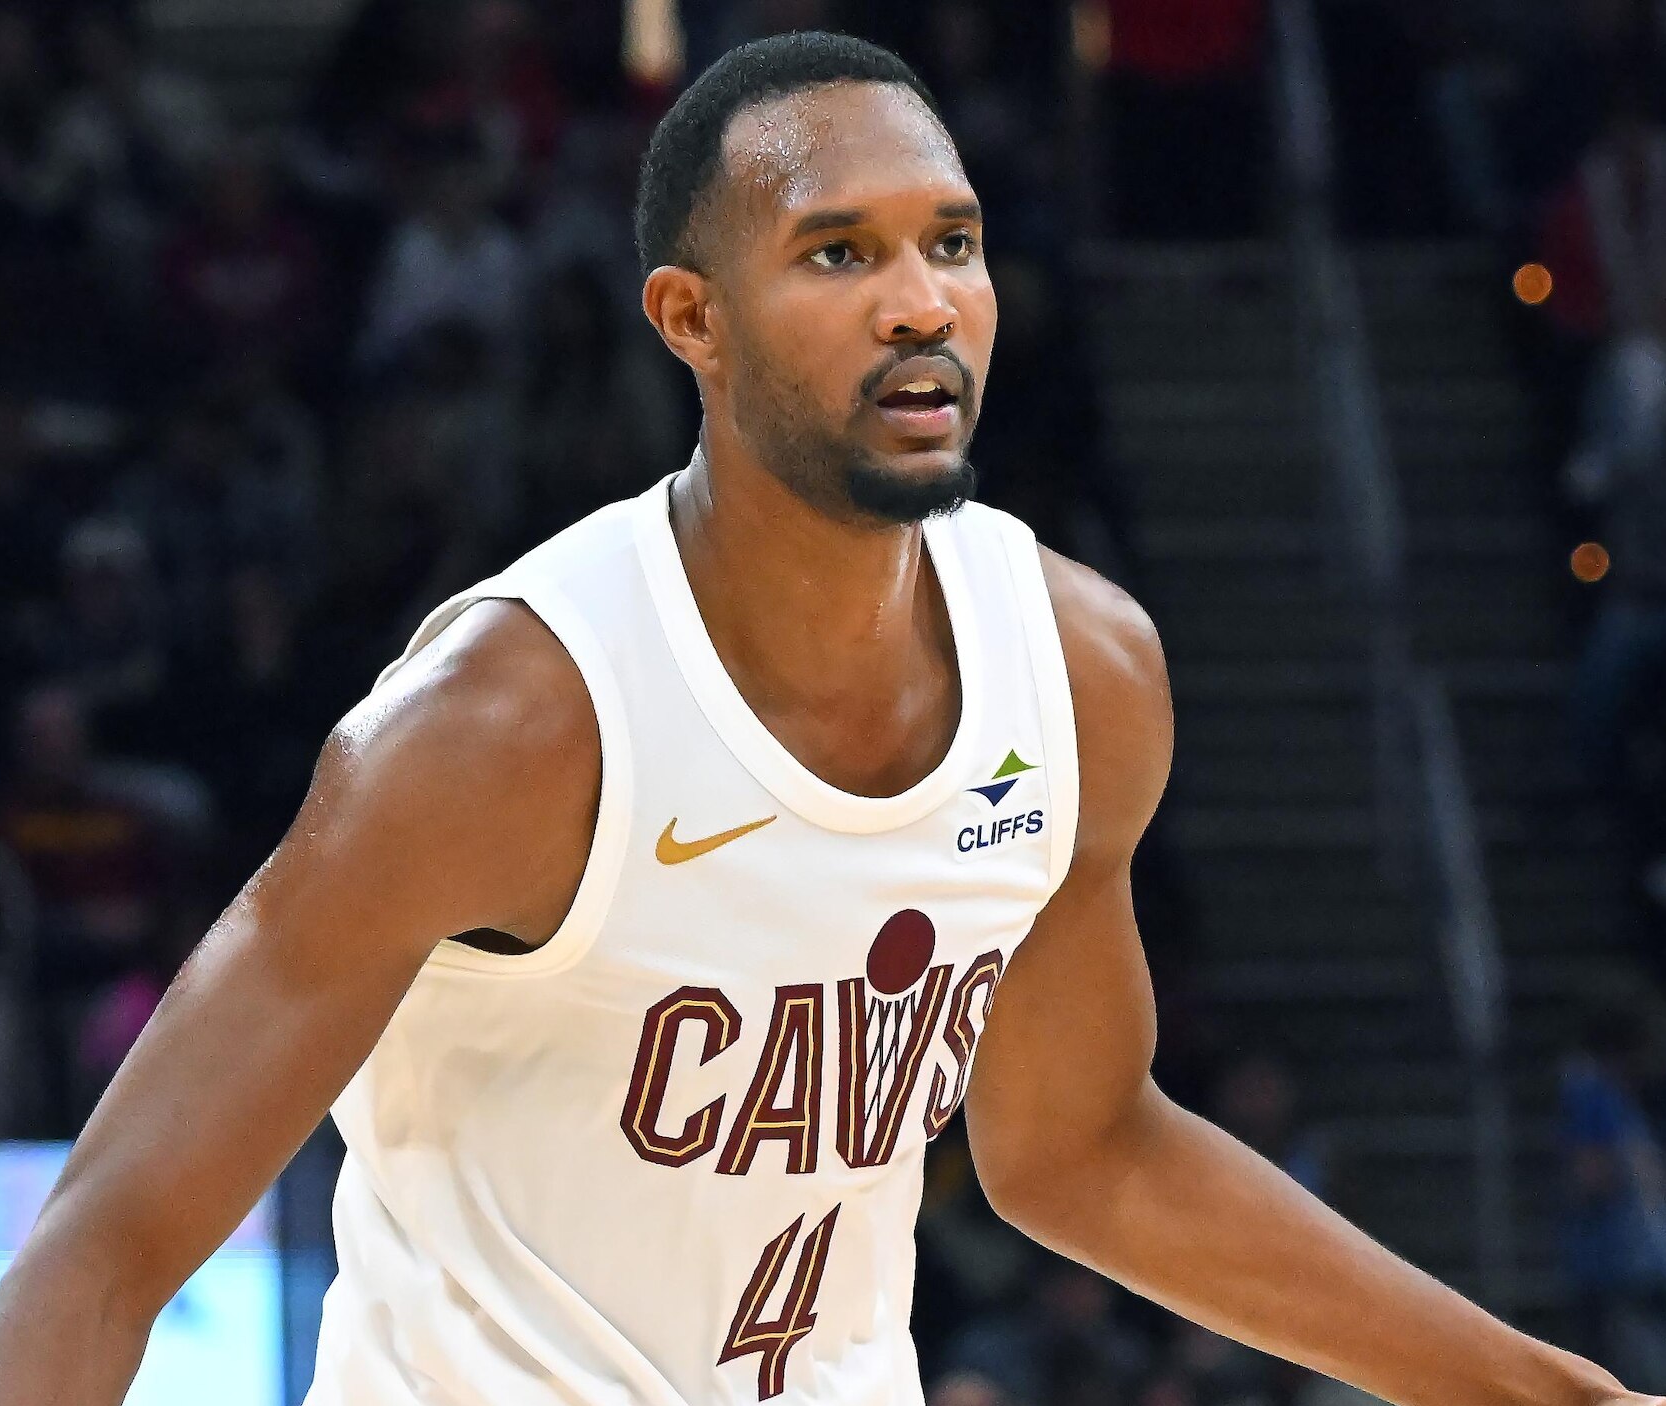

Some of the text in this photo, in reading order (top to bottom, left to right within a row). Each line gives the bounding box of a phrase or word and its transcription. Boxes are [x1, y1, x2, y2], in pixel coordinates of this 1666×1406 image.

[957, 810, 1044, 853] CLIFFS
[619, 947, 1004, 1176] CAVS
[716, 1201, 842, 1403] 4
